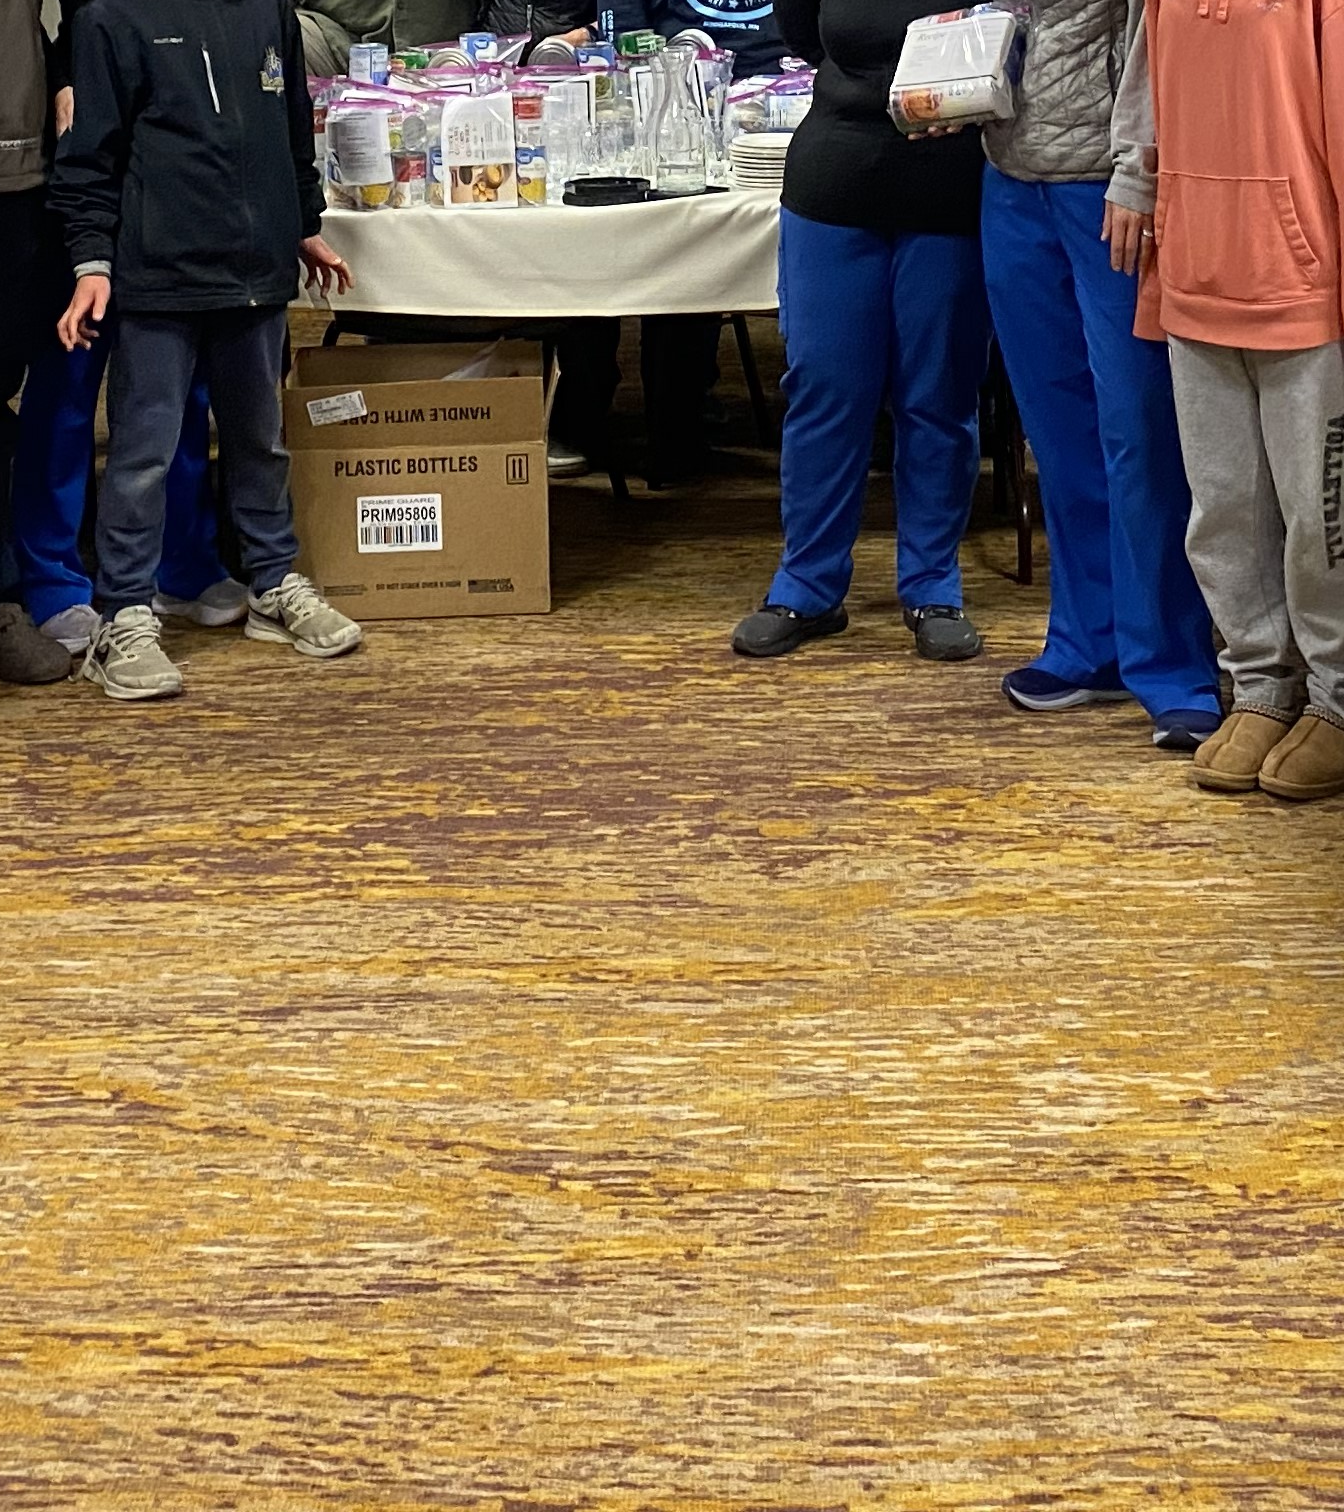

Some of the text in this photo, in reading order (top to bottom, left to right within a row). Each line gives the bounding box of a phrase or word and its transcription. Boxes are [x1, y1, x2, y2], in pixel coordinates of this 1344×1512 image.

[384, 408, 425, 424] WITH
[429, 406, 491, 422] HANDLE
[334, 455, 478, 477] PLASTIC BOTTLES
[361, 506, 436, 523] PRIM95806
